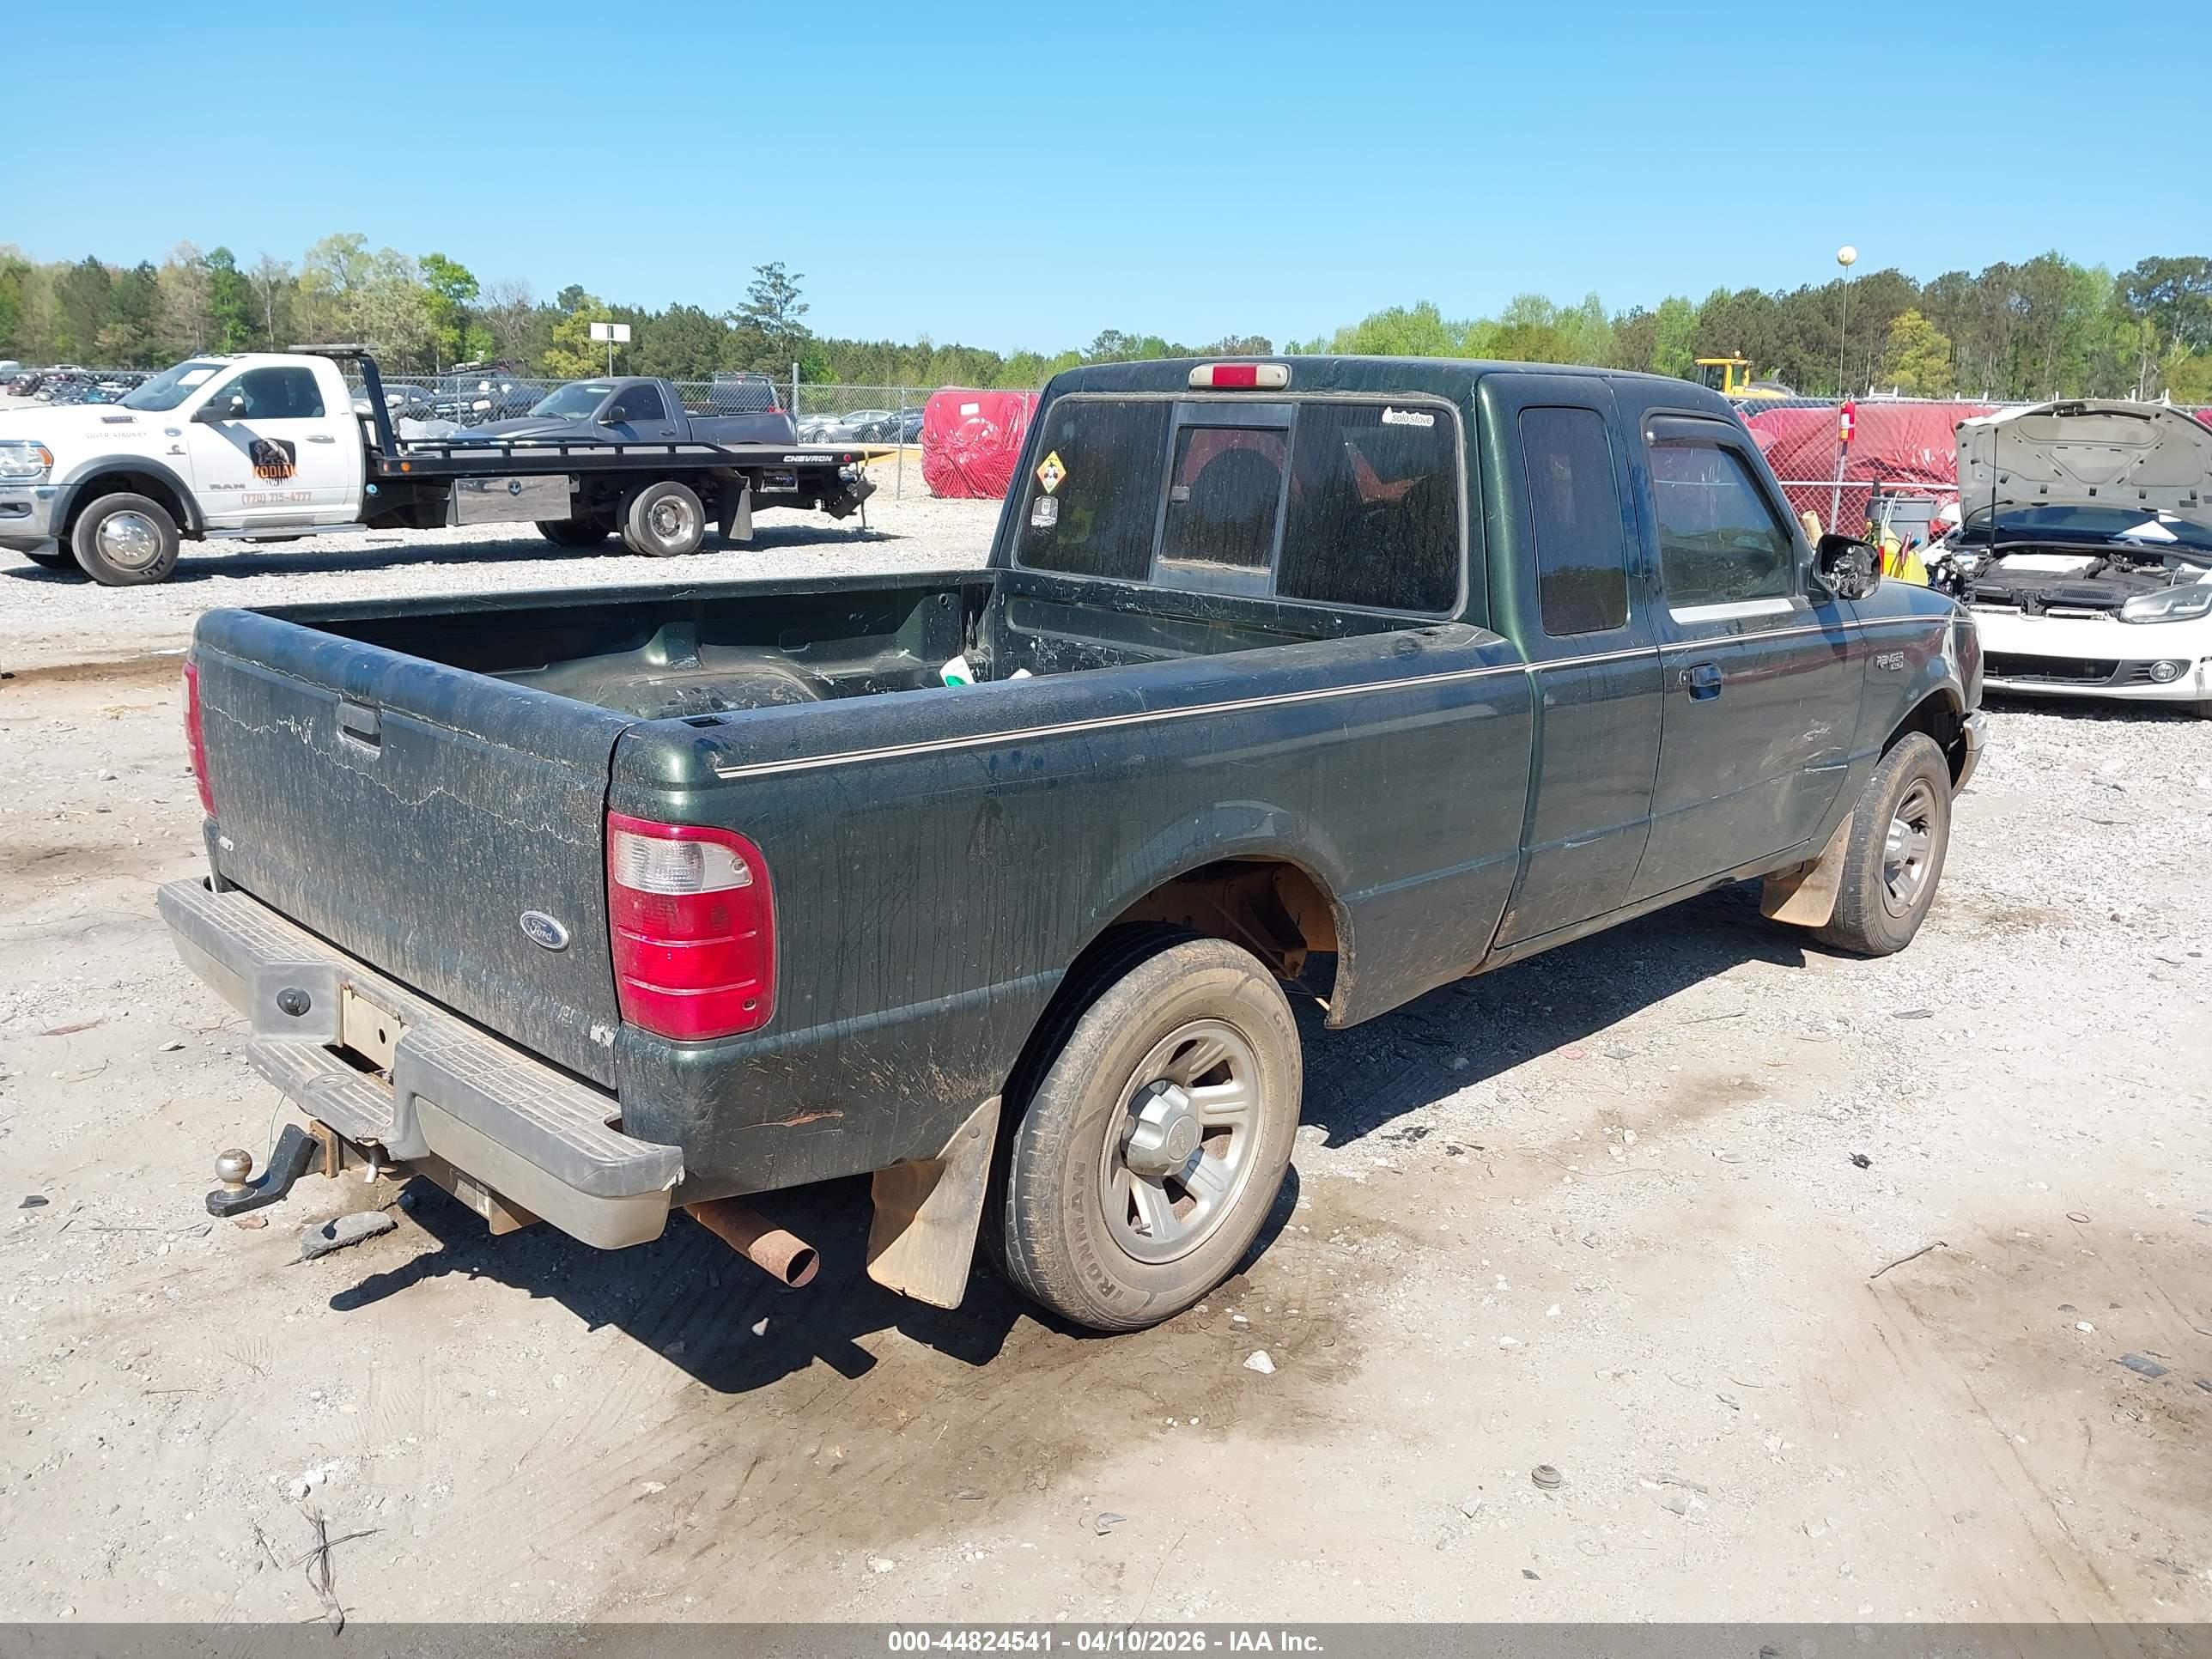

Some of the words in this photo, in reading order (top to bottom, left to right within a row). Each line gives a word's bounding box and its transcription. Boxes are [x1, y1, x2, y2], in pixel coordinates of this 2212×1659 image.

[1391, 413, 1409, 423] solo
[1409, 414, 1433, 425] stove
[783, 454, 833, 463] CHEVRON
[252, 464, 298, 478] KODIAK
[1876, 651, 1904, 668] RANGER
[1070, 1160, 1126, 1302] IRONMAN
